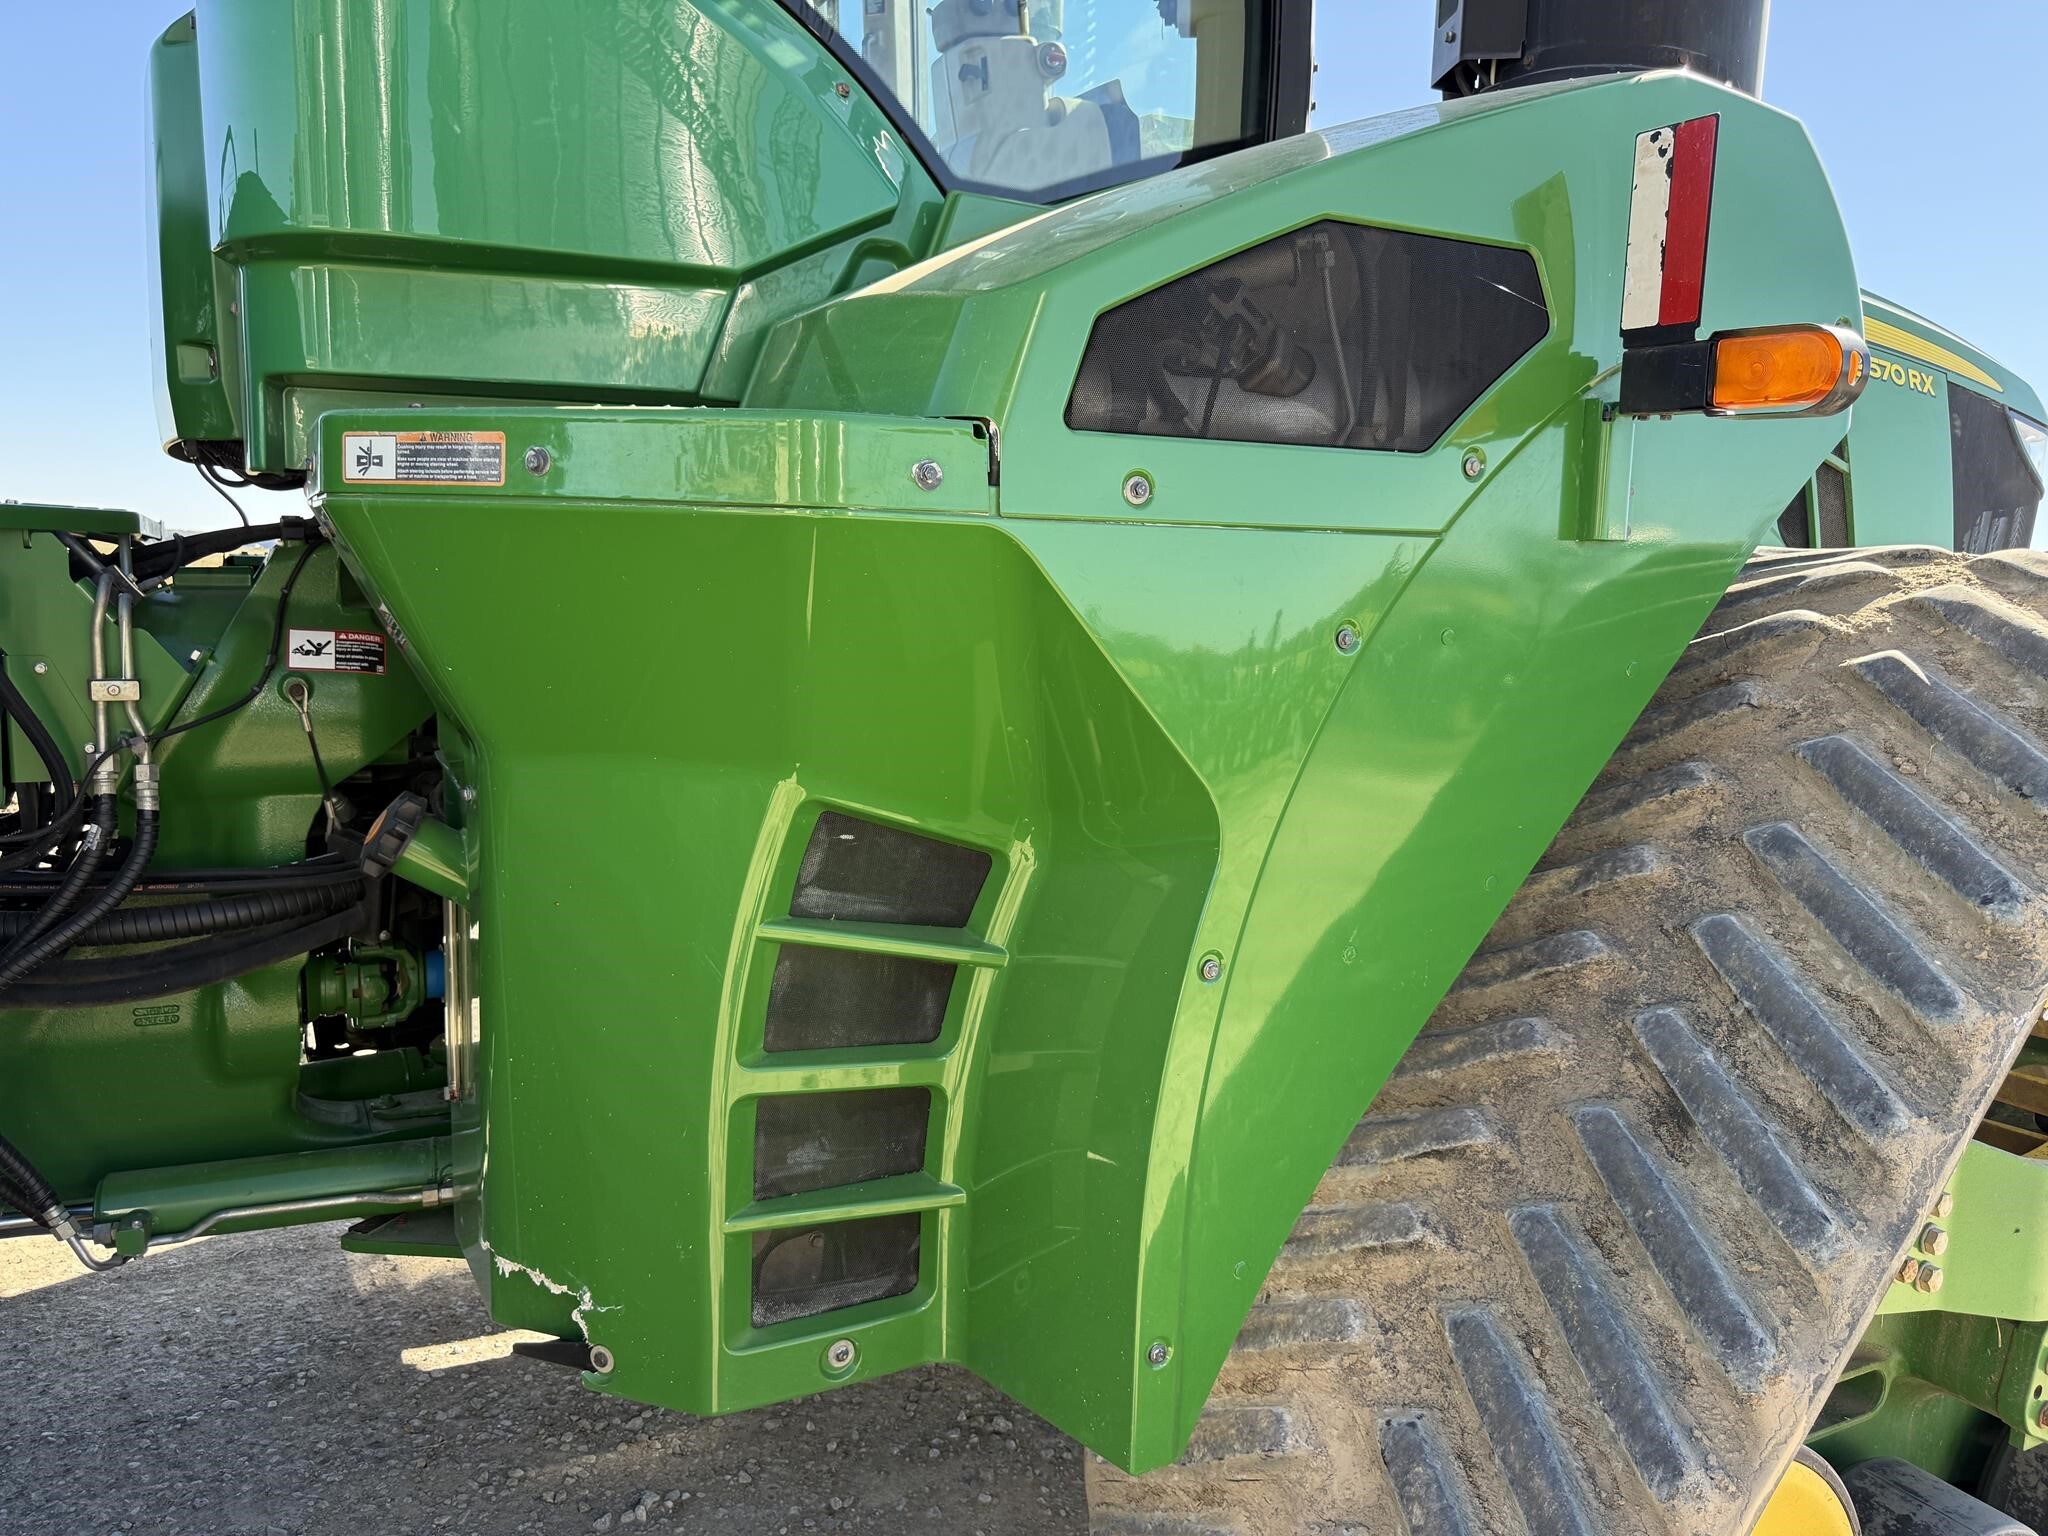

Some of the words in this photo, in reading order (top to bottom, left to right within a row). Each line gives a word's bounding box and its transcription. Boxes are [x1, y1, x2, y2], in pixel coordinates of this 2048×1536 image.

[1908, 368, 1936, 397] RX
[430, 433, 473, 442] WARNING
[348, 633, 380, 642] DANGER
